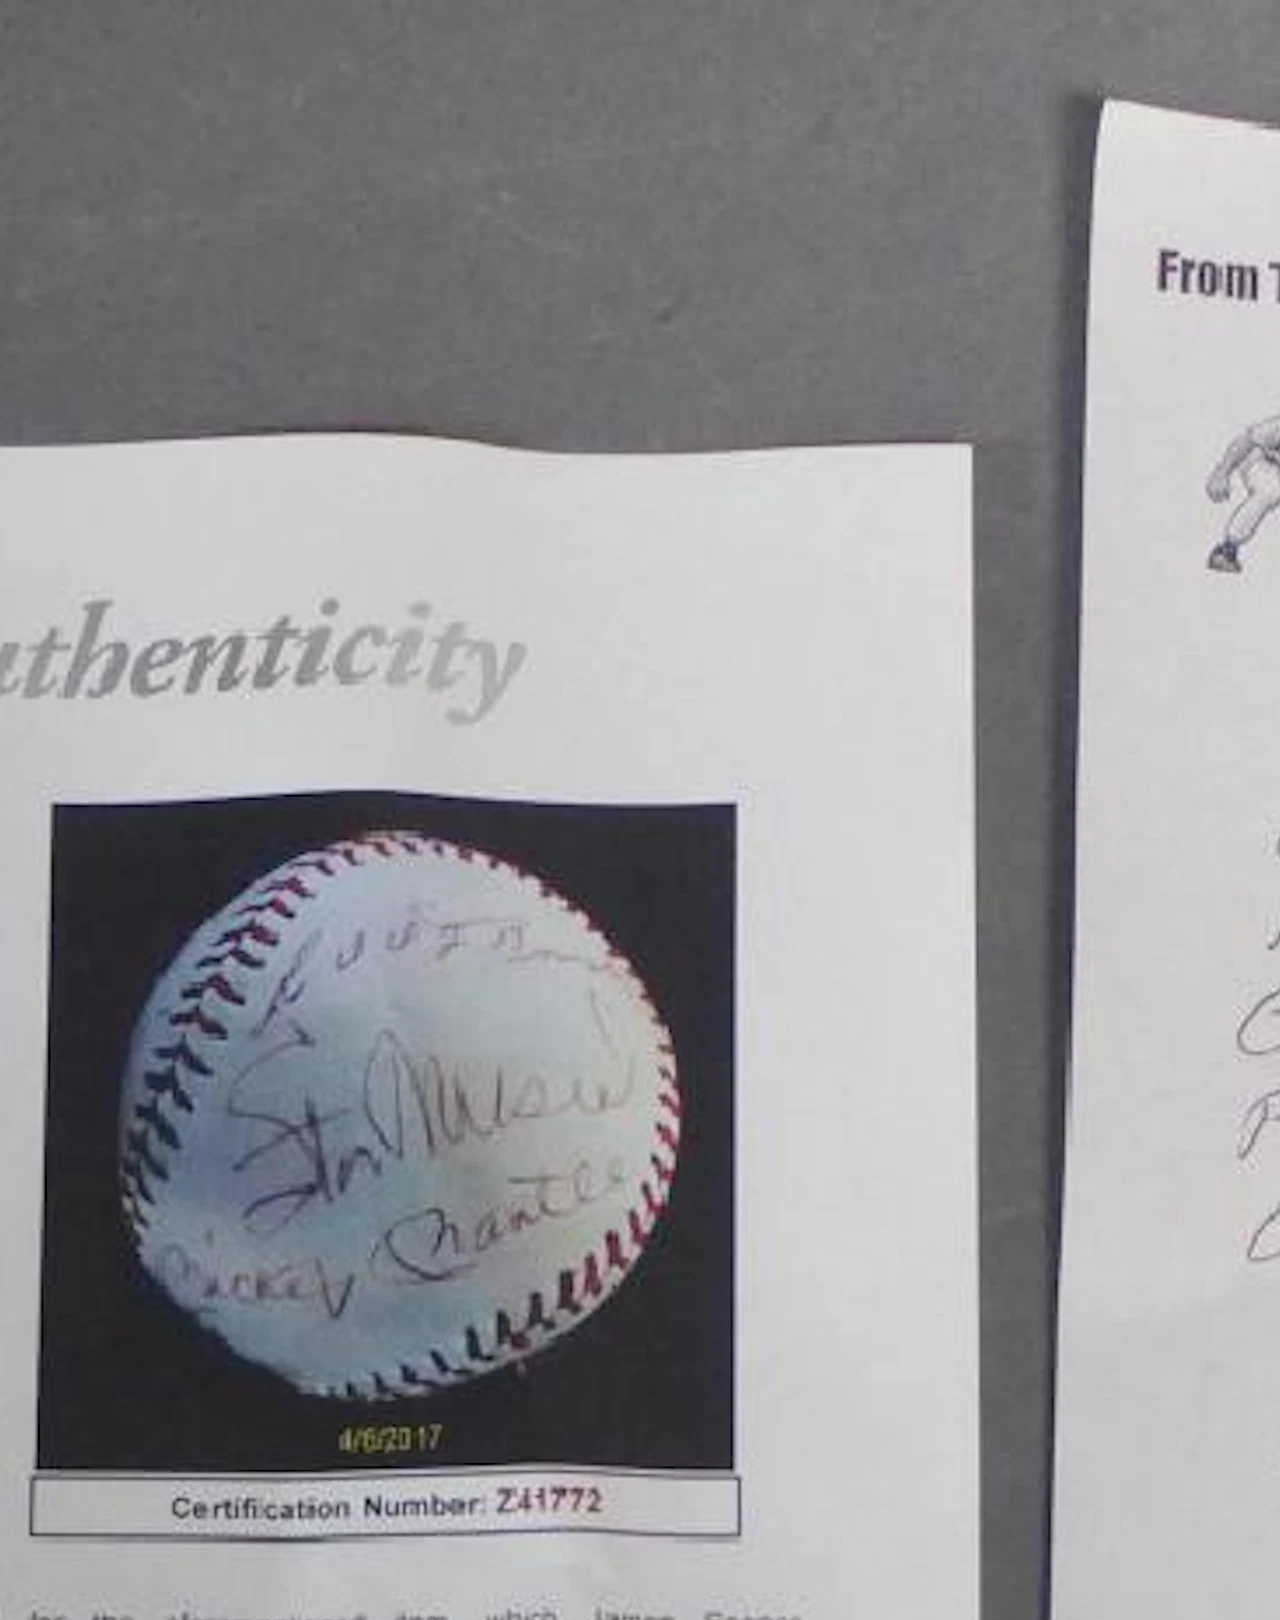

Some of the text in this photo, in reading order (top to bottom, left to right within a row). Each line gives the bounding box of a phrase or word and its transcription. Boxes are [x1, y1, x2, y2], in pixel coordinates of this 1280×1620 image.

[1156, 248, 1260, 302] From
[171, 1495, 352, 1522] Certification
[495, 1485, 603, 1516] Z41772
